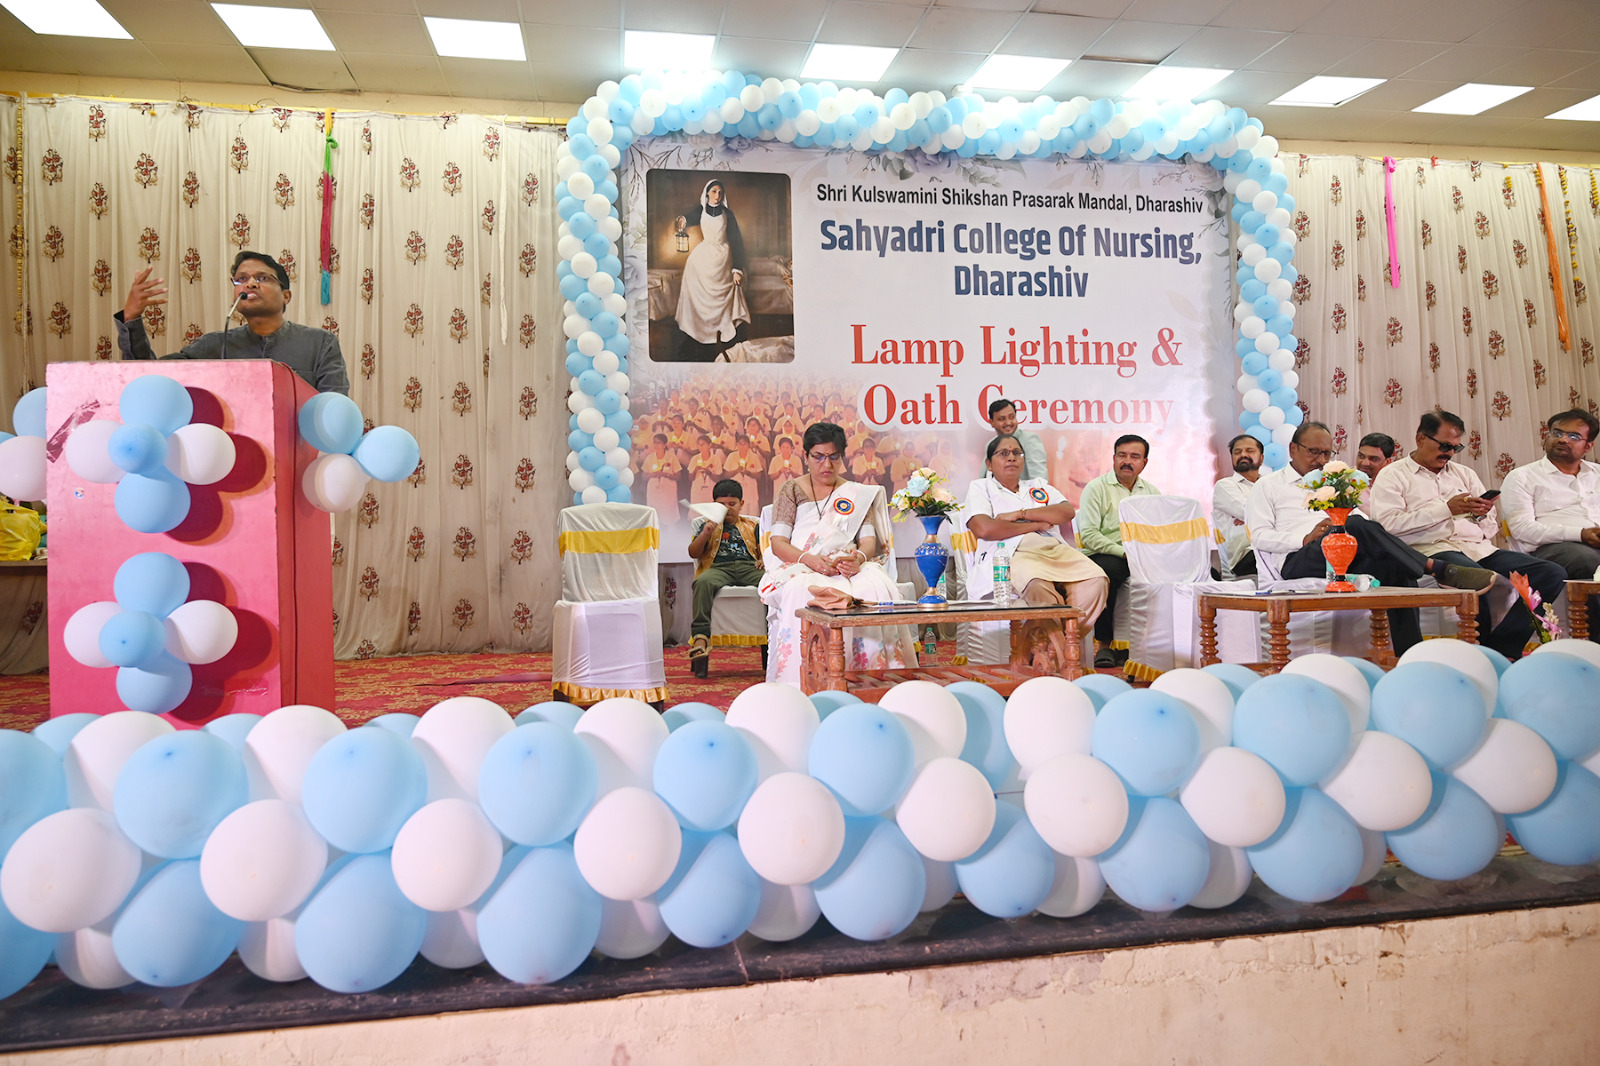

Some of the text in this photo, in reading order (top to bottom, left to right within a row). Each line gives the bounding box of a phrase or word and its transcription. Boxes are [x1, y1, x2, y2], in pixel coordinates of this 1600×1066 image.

[817, 184, 1203, 214] Shri Kulswamini Shikshan Prasarak Mandal, Dharashiv
[820, 218, 1202, 265] Sahyadri College Of Nursing,
[954, 264, 1089, 298] Dharashiv
[850, 324, 1184, 378] Lamp Lighting &
[863, 383, 963, 426] Oath
